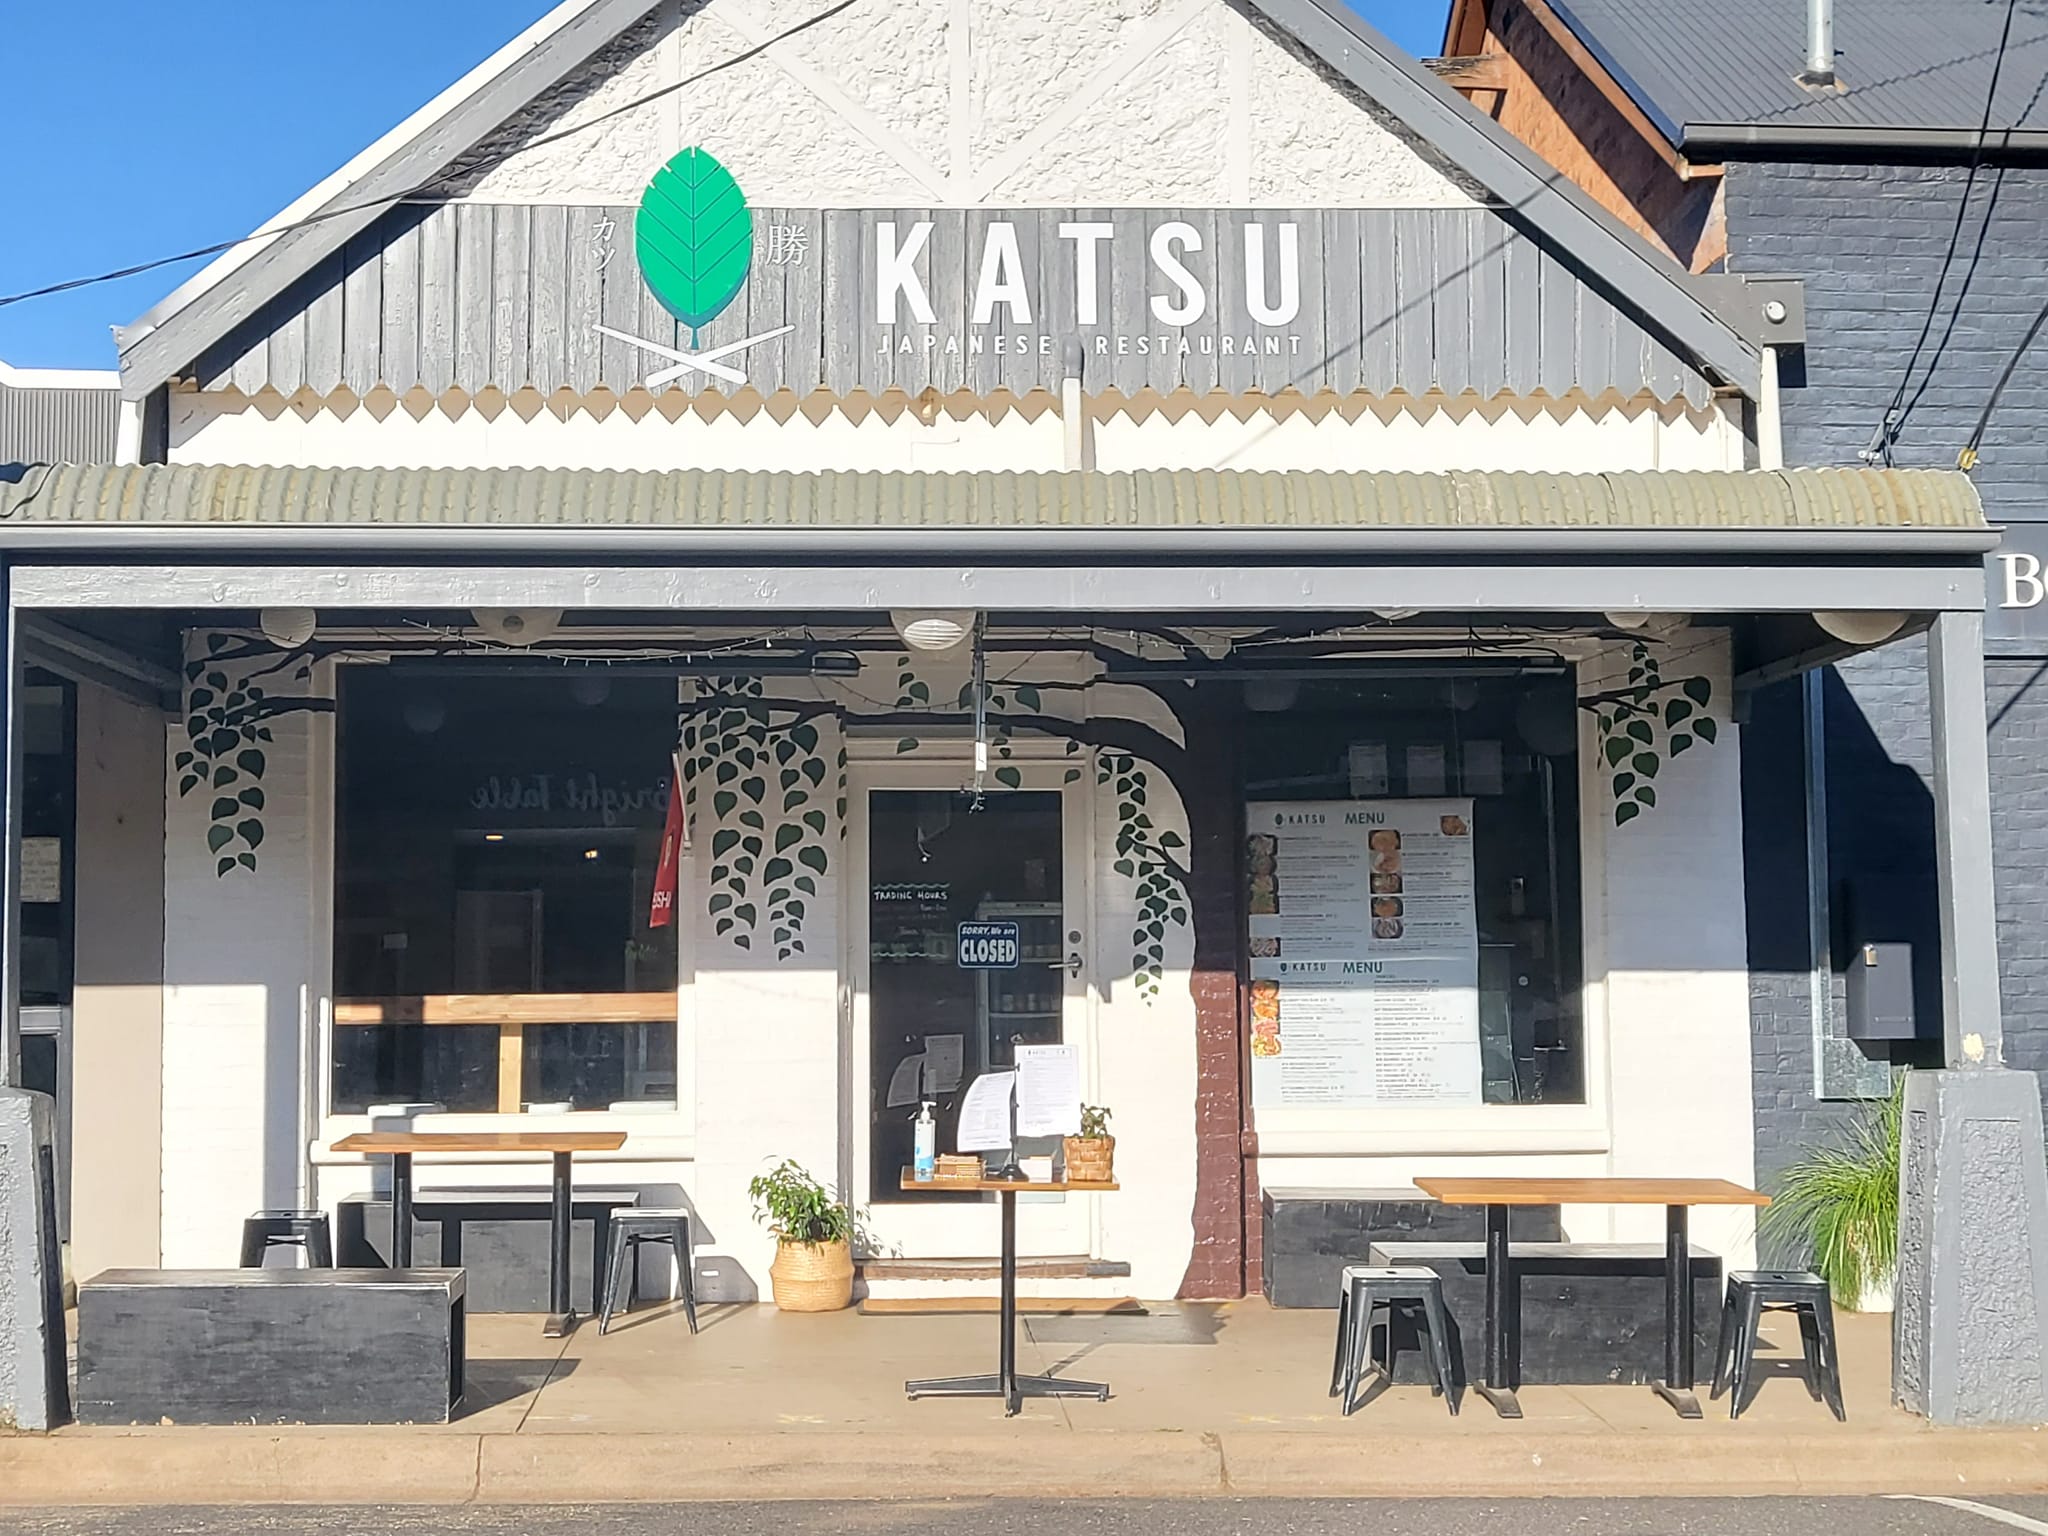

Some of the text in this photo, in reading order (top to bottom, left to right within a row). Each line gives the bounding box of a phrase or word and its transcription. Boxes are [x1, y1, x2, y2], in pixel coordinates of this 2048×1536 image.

[591, 216, 617, 272] カツ
[766, 224, 809, 267] 勝
[877, 221, 1301, 326] KATSU
[877, 335, 1303, 356] JAPANESE RESTAURANT
[1997, 553, 2048, 609] B
[1288, 812, 1385, 825] KATSU MENU
[873, 890, 948, 901] TRADING HOURS
[1003, 927, 1016, 935] are
[960, 938, 1016, 963] CLOSED
[1292, 961, 1383, 974] KATSU MENU
